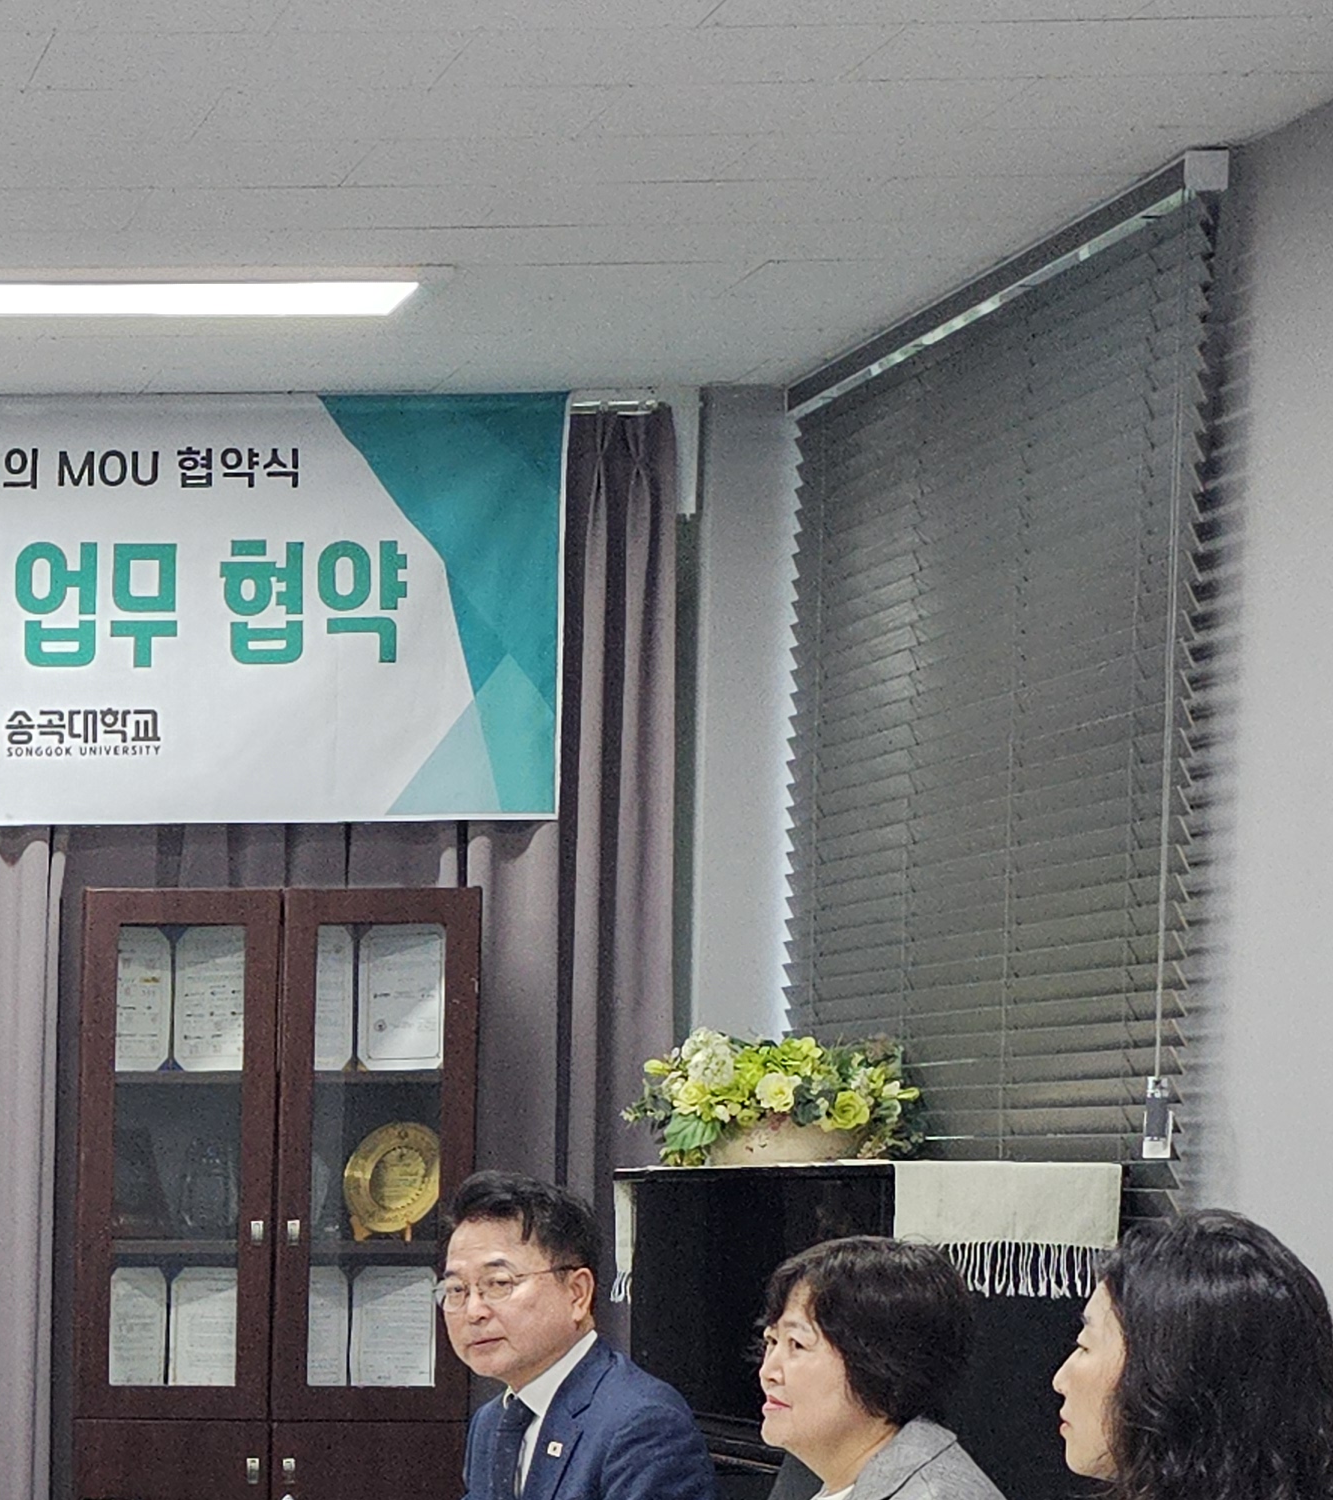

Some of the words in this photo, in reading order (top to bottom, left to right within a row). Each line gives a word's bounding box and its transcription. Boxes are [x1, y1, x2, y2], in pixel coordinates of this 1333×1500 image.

[57, 449, 160, 487] MOU
[176, 446, 299, 489] 협약식
[14, 541, 178, 668] 업무
[219, 538, 407, 665] 협약
[4, 707, 162, 745] 송곡대학교
[6, 746, 72, 758] SONGGOK
[79, 745, 161, 757] UNIVERSITY
